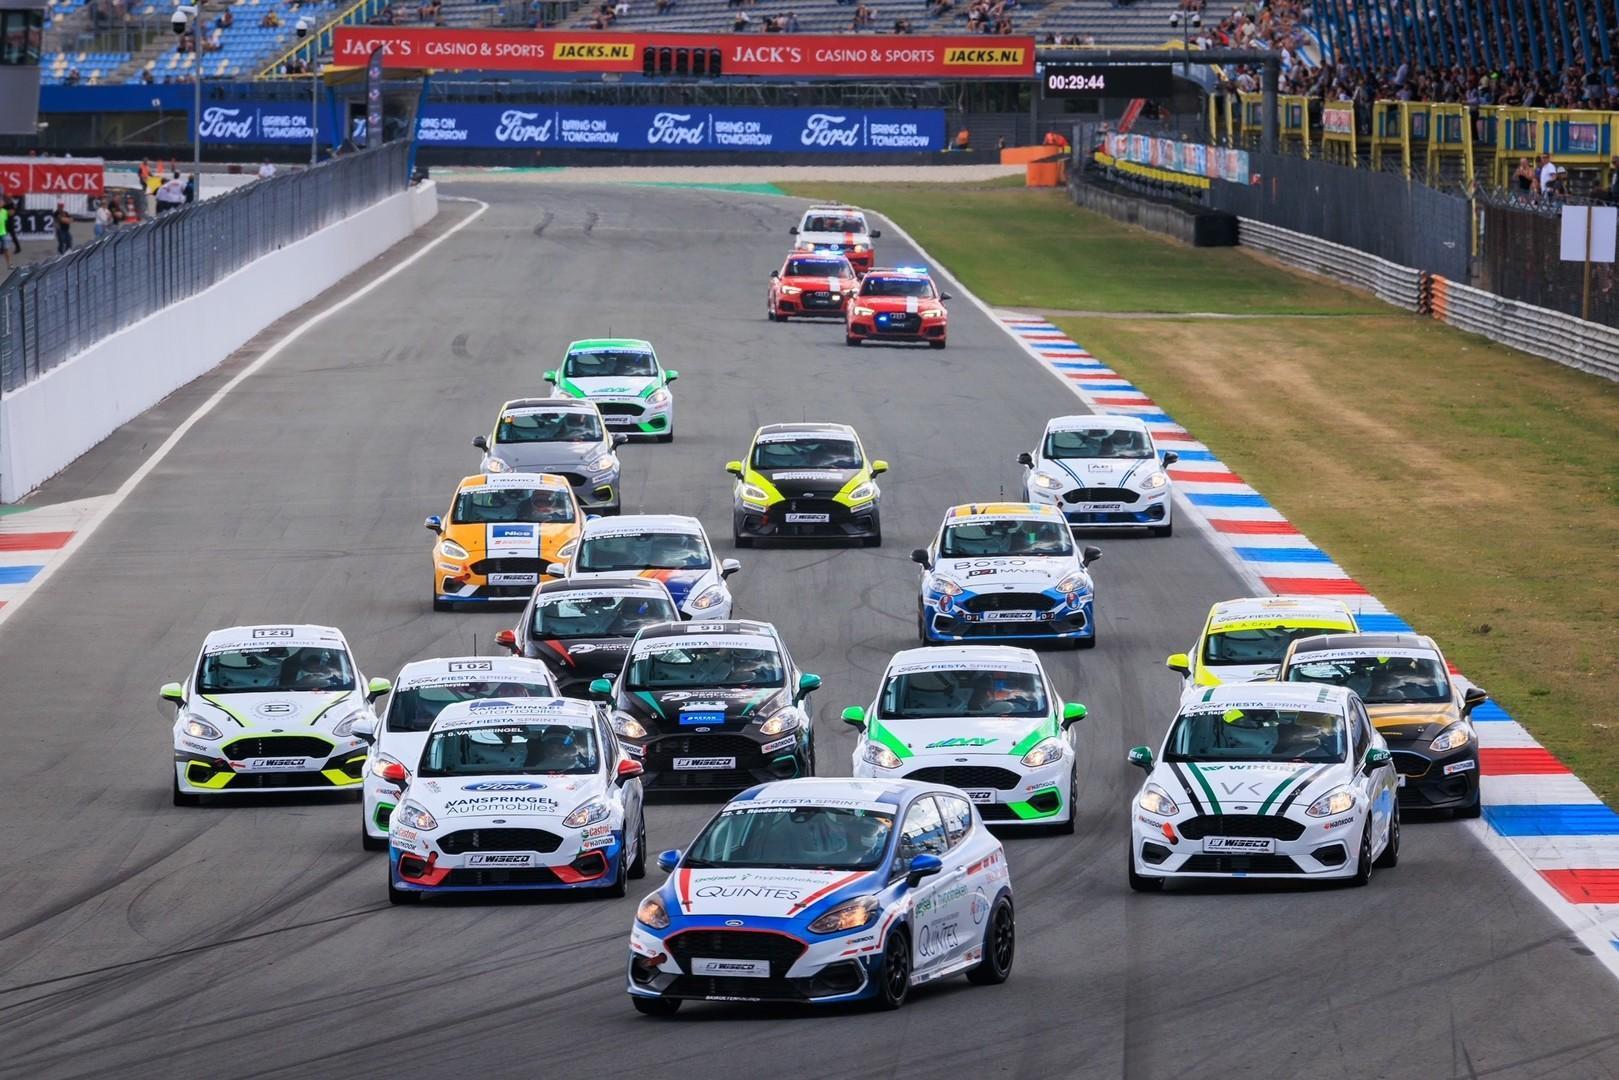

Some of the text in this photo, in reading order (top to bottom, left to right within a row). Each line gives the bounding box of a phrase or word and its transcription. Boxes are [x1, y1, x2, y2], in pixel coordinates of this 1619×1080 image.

[342, 38, 545, 58] JACK'S CASINO & SPORTS
[558, 43, 631, 59] JACKS.NL
[732, 46, 935, 64] JACK'S CASINO & SPORTS
[949, 50, 1019, 63] JACKS.NL
[1048, 74, 1105, 91] 00:29:44
[199, 106, 254, 139] Ford
[262, 115, 307, 127] BRING ON
[440, 117, 457, 129] ON
[495, 109, 553, 143] Ford
[562, 118, 607, 131] BRING ON
[715, 121, 761, 133] BRING ON
[647, 111, 704, 145] Ford
[800, 113, 860, 147] Ford
[870, 122, 918, 135] BRING ON
[417, 129, 468, 141] OMORROW
[562, 131, 619, 143] TOMORROW
[715, 133, 772, 146] TOMORROW
[870, 134, 930, 148] TOMORROW
[41, 172, 100, 190] JACK
[447, 796, 557, 806] VANSPRINGEL
[814, 799, 861, 807] SPRINT
[446, 802, 556, 816] Automobiles
